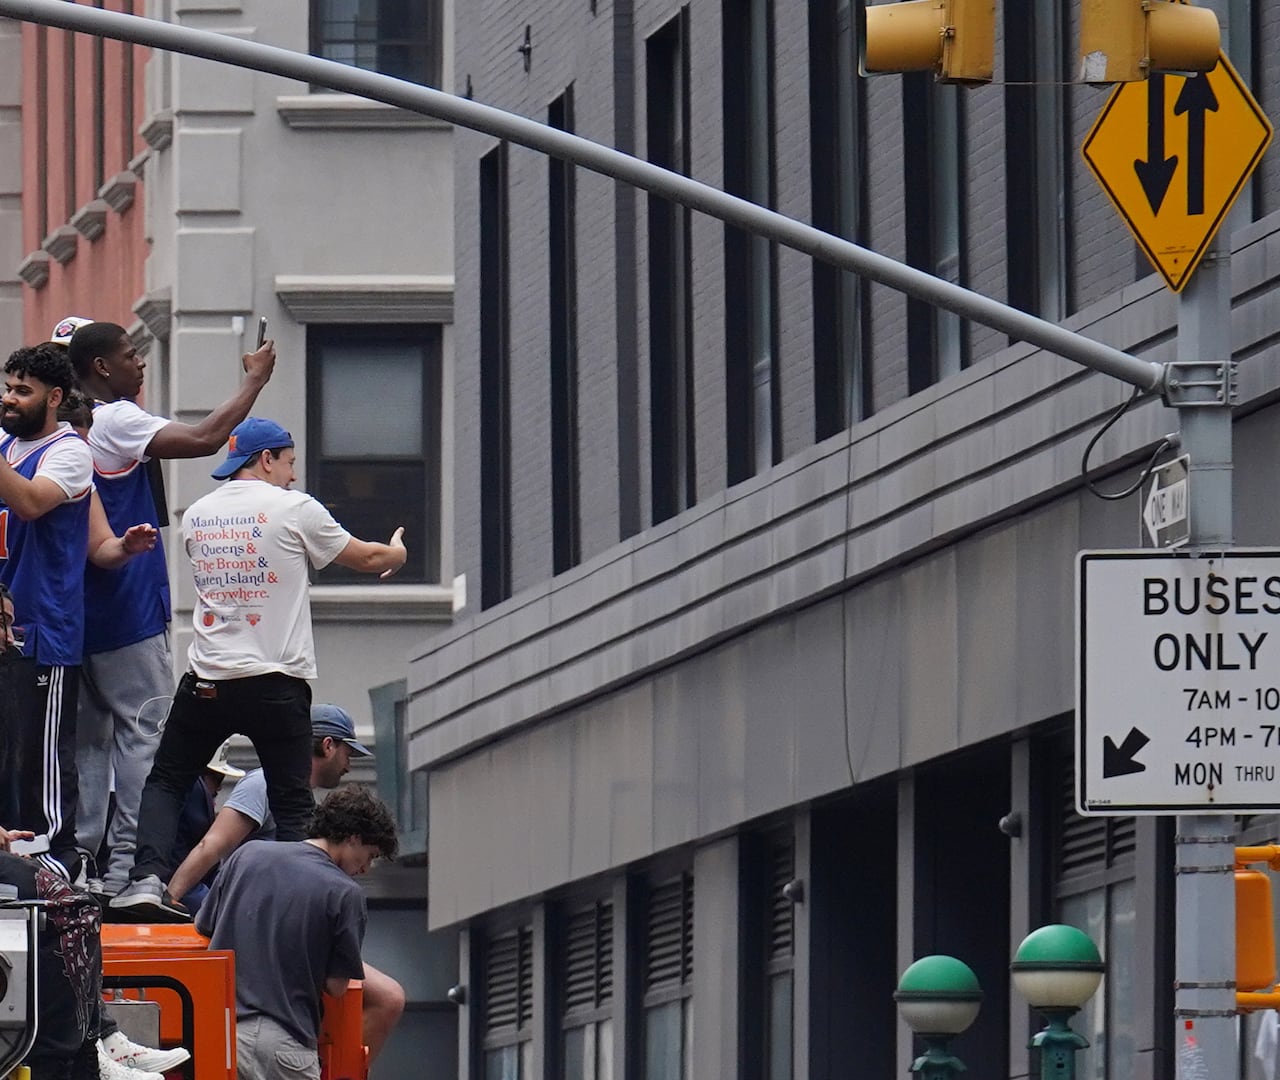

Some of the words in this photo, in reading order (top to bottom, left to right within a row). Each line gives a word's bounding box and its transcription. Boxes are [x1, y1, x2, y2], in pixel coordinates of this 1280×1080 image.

[191, 516, 255, 529] Manhattan
[257, 512, 268, 524] &
[195, 529, 252, 542] Brooklyn
[252, 526, 262, 538] &
[201, 543, 244, 557] Queens
[246, 542, 256, 554] &
[196, 560, 214, 573] The
[216, 558, 256, 572] Bronx
[258, 556, 268, 568] &
[194, 575, 224, 588] Saten
[225, 572, 265, 586] Island
[268, 571, 278, 583] &
[203, 588, 270, 601] verywhere.
[1144, 576, 1280, 615] BUSES
[1154, 632, 1269, 671] ONLY
[1183, 688, 1231, 711] 7AM
[1186, 726, 1235, 748] 4PM
[1260, 725, 1280, 747] 7
[1175, 762, 1222, 786] MON
[1235, 766, 1275, 782] THRU
